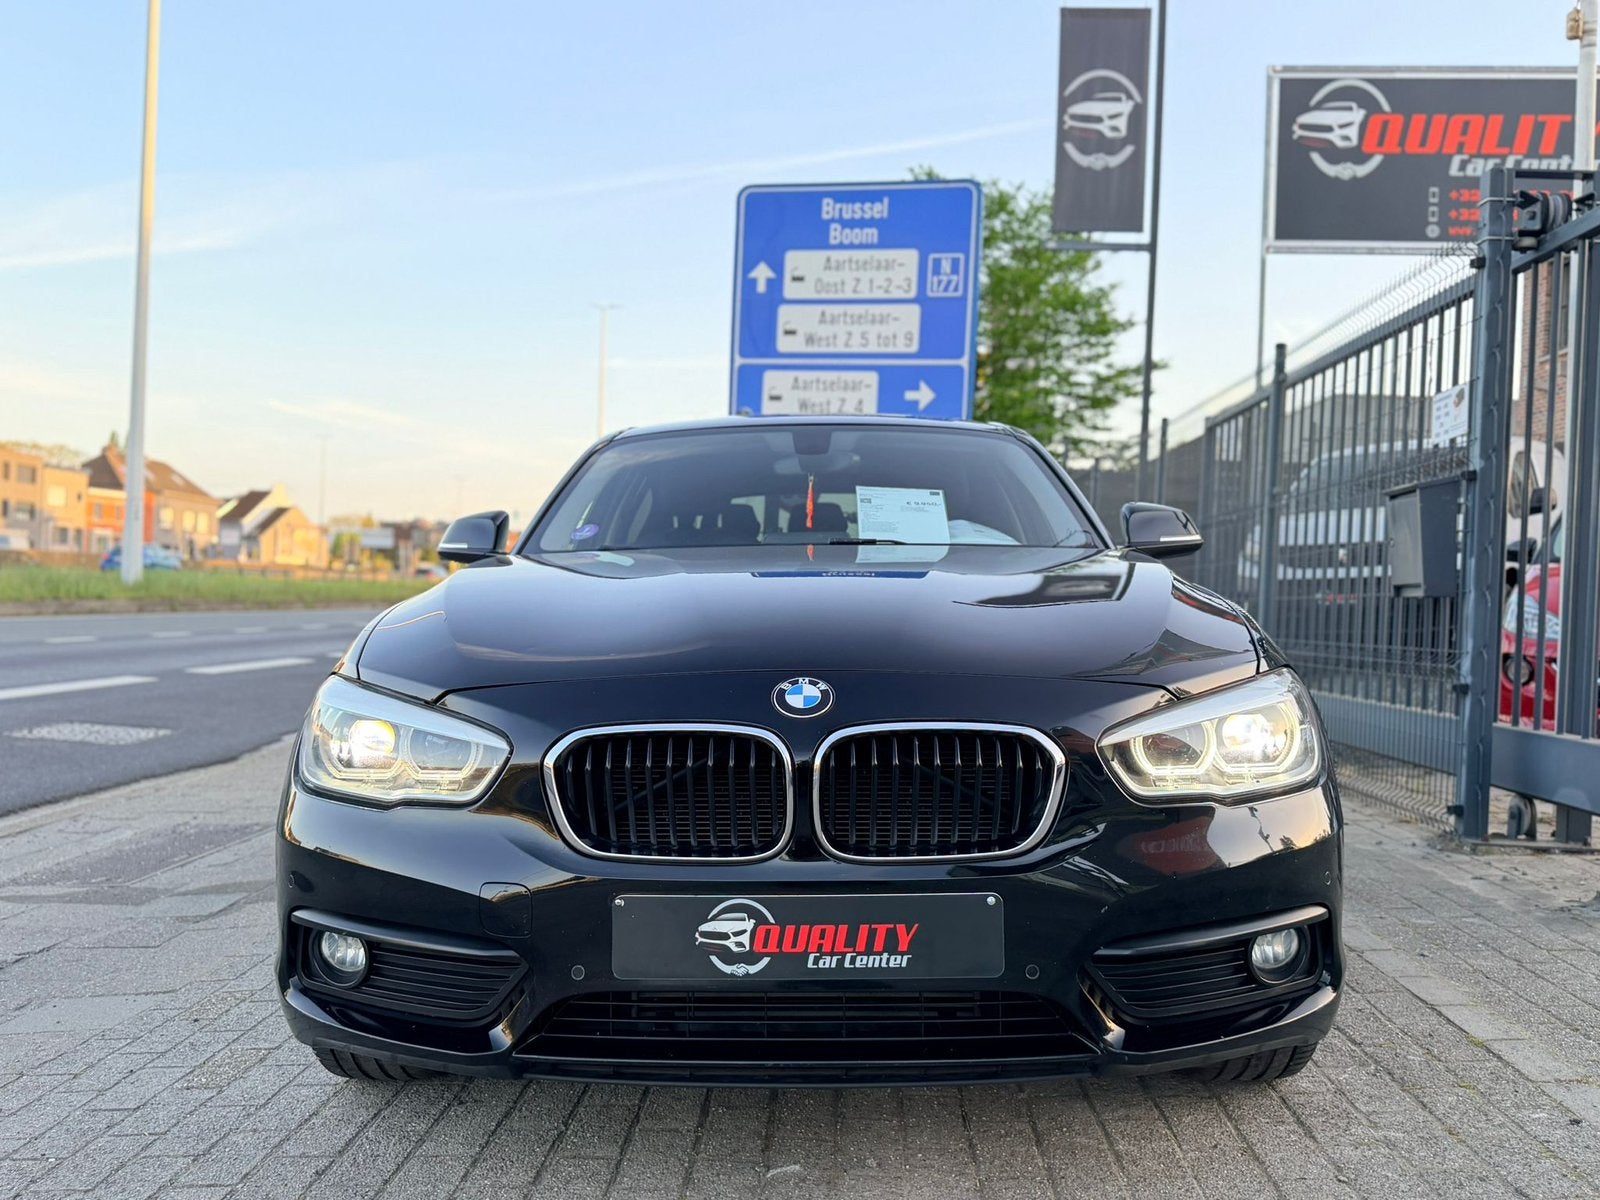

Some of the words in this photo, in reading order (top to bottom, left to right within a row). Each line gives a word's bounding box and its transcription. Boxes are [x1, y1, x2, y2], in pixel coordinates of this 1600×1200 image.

[1362, 113, 1600, 155] QUALIT
[821, 195, 889, 220] Brussel
[829, 222, 879, 245] Boom
[823, 256, 905, 271] Aartselaar-
[941, 257, 951, 274] N
[932, 275, 958, 292] 177
[818, 309, 900, 325] Aartselaar-
[803, 332, 838, 347] West
[876, 332, 897, 347] tot
[904, 331, 914, 347] 9
[791, 376, 872, 391] Aartselaar-
[780, 678, 828, 691] BMW
[753, 923, 919, 953] QUALITY
[807, 953, 842, 969] Car
[844, 953, 912, 968] Center
